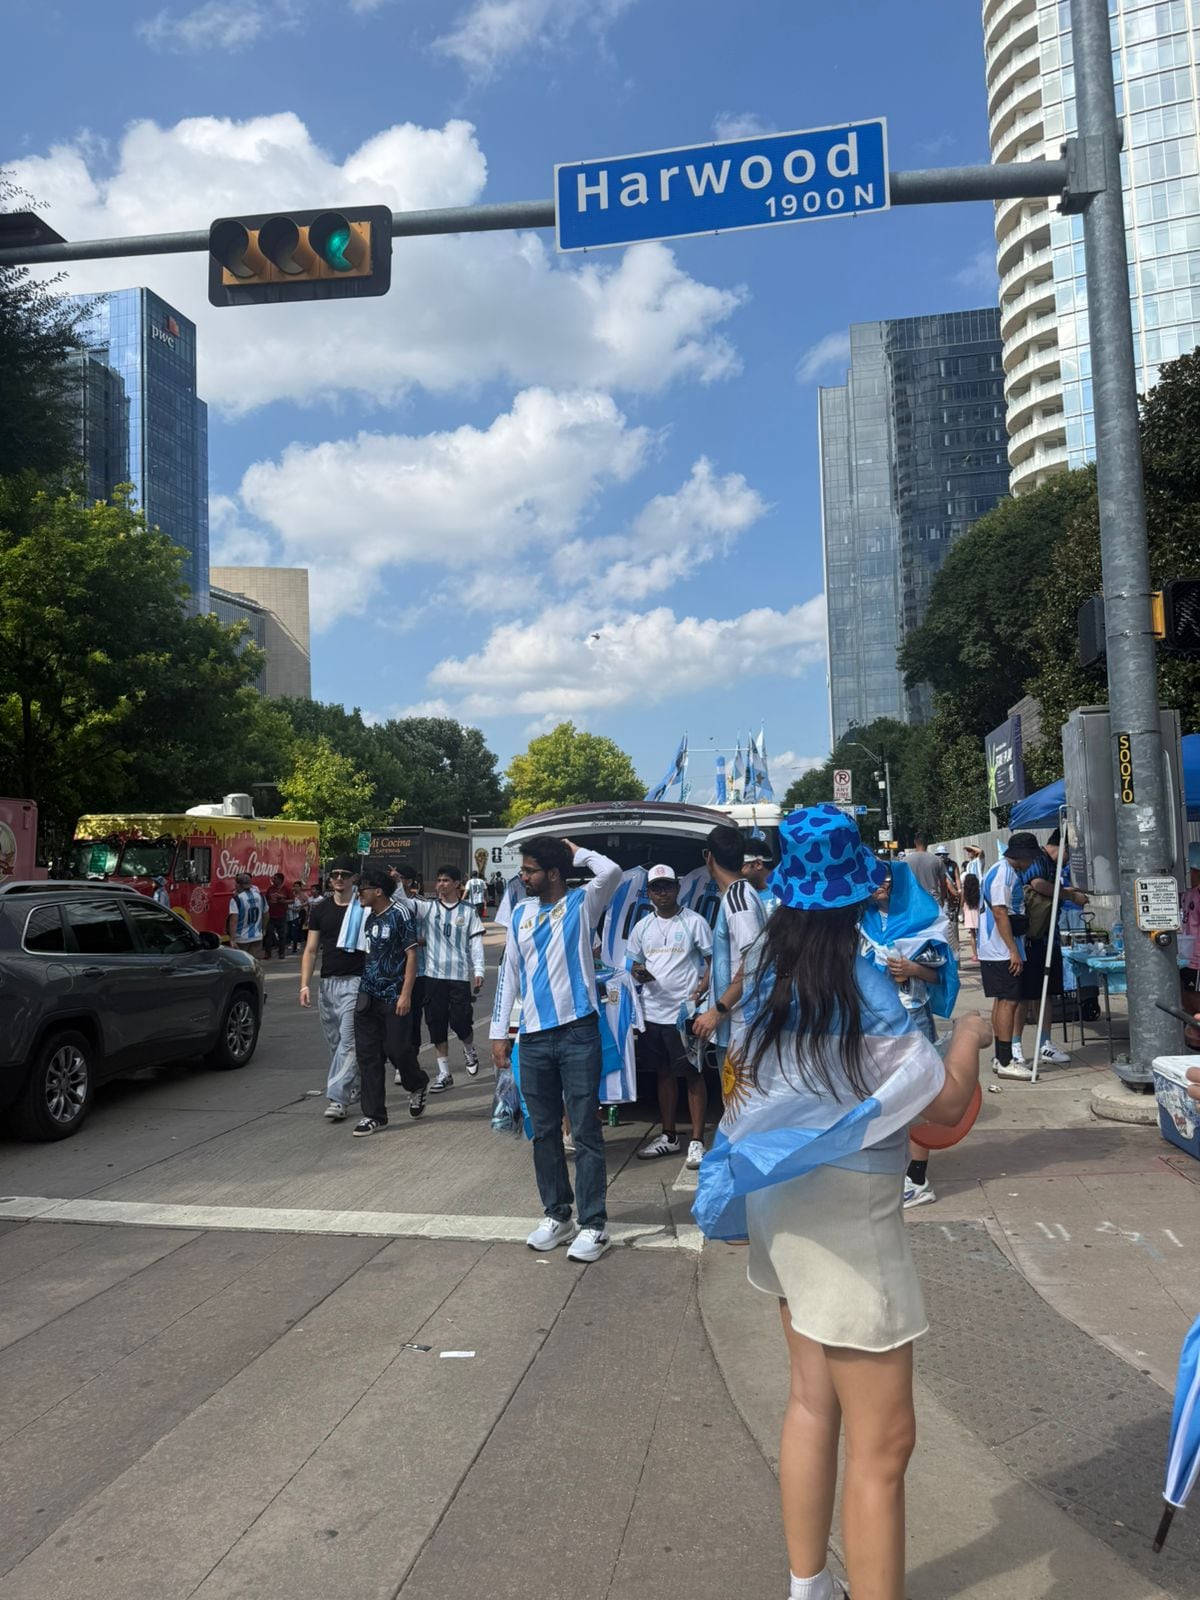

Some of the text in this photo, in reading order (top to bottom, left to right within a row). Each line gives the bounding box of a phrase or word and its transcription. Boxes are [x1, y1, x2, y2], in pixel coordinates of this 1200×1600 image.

[577, 131, 859, 213] Harwood
[765, 183, 874, 218] 1900 N
[151, 324, 175, 349] pwc
[1120, 735, 1133, 803] S0070
[381, 837, 411, 848] Cocina
[216, 850, 280, 879] Stay Corny
[248, 907, 260, 924] 10
[443, 923, 452, 937] 10
